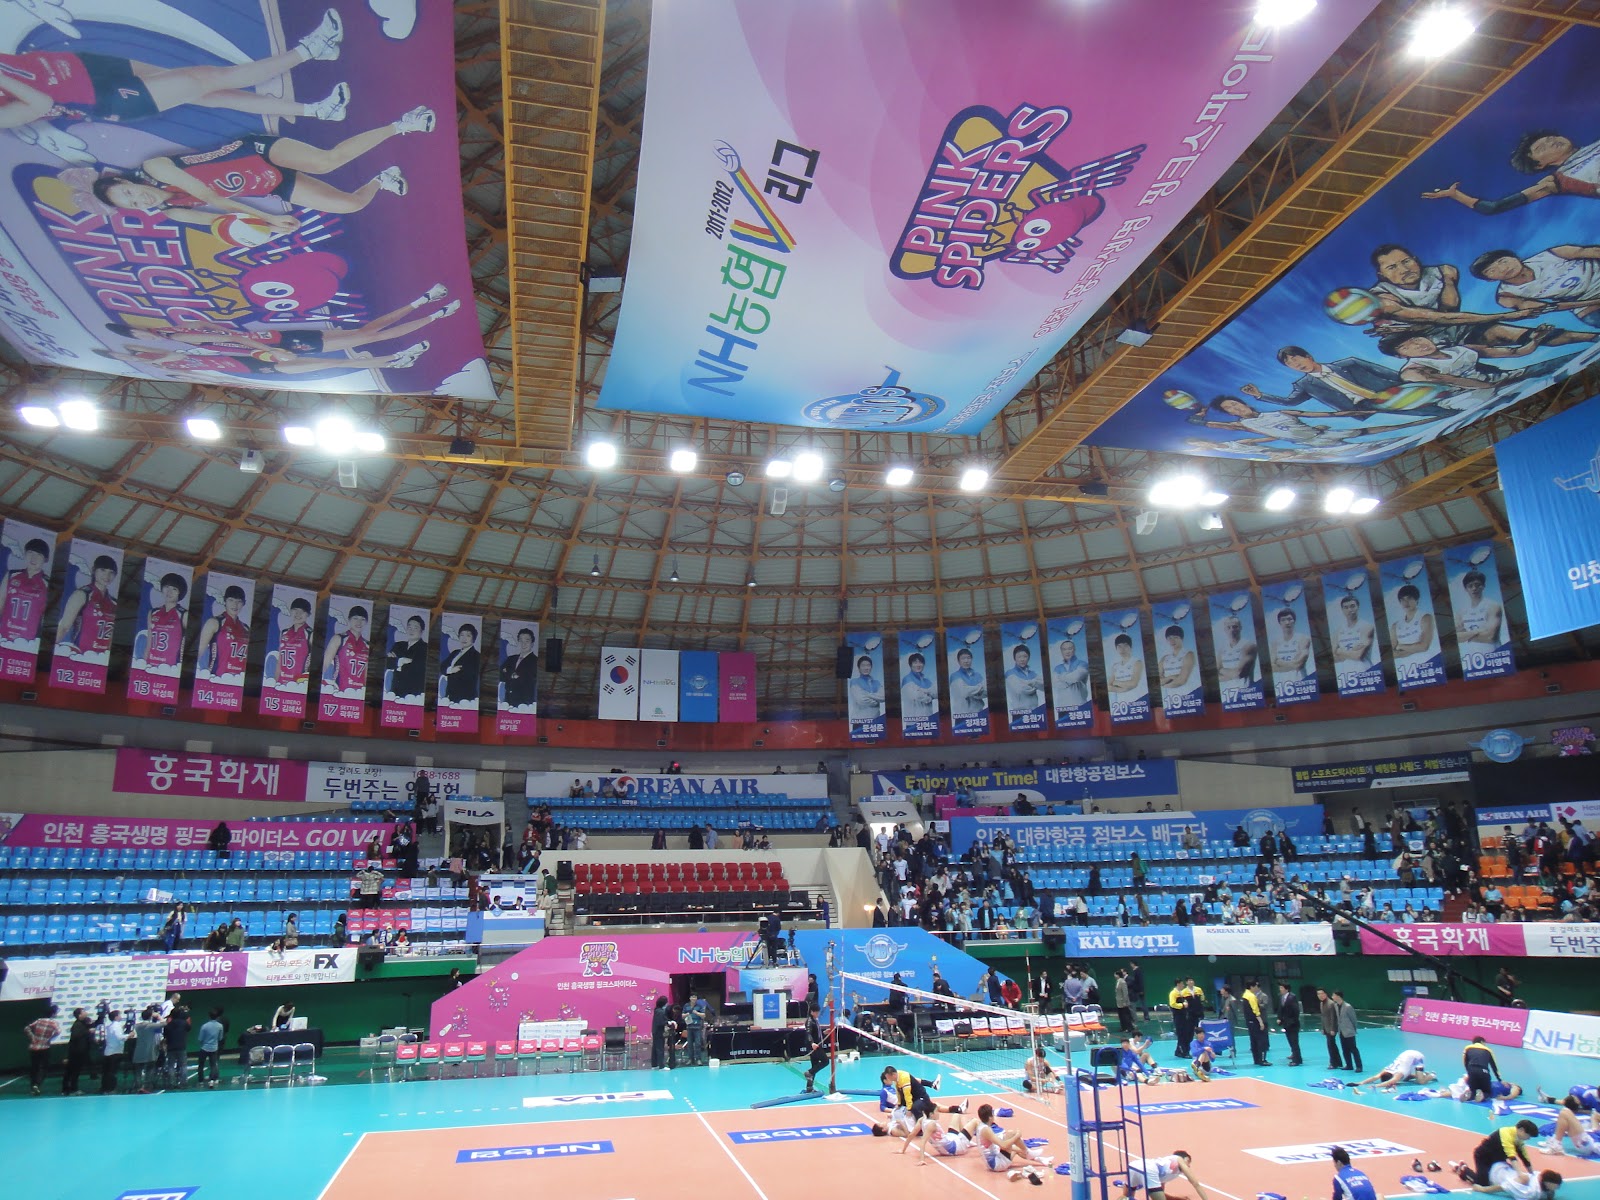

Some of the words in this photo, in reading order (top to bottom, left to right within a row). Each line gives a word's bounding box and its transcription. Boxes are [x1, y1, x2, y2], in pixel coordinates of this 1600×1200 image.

[906, 141, 995, 265] PINK
[937, 104, 1069, 290] SPIDERS
[705, 179, 735, 240] 2011-2012
[34, 200, 166, 318] PINK
[1063, 213, 1153, 300] 흥국생명
[1463, 652, 1485, 670] 10
[57, 669, 74, 683] 12
[1338, 671, 1358, 688] 15
[1398, 663, 1419, 680] 14
[134, 680, 150, 695] 13
[1222, 687, 1240, 703] 17
[1277, 680, 1294, 697] 16
[198, 690, 214, 704] 14
[265, 697, 281, 711] 15
[1163, 694, 1182, 709] 19
[323, 704, 339, 717] 17
[1112, 701, 1128, 716] 20
[147, 754, 279, 796] 흥국화재
[993, 770, 1039, 787] Time!
[1046, 763, 1146, 784] 대한항공점보스
[323, 778, 400, 800] 두번주는
[713, 777, 760, 794] AIR
[454, 807, 494, 818] FILA
[870, 810, 907, 818] FILA
[1477, 810, 1525, 821] KOREAN
[1526, 808, 1550, 818] AIR
[44, 822, 84, 843] 인천
[90, 823, 168, 845] 흥국생명
[175, 826, 299, 847] 핑크파이더스
[305, 829, 345, 847] GO!
[352, 829, 385, 846] V4!
[1017, 826, 1086, 847] 대한항공
[1092, 825, 1148, 846] 점보스
[1078, 936, 1116, 950] KAL
[1116, 934, 1180, 950] HOTEL
[1393, 926, 1490, 952] 흥국화재
[590, 944, 610, 952] PINK
[170, 955, 233, 977] FOXlife
[314, 953, 340, 969] FX
[190, 976, 228, 986] 함께합니다
[1425, 1011, 1440, 1022] 인천
[1441, 1012, 1470, 1025] 흥국생명
[741, 1126, 862, 1141] NH농협
[470, 1143, 601, 1160] NH농협
